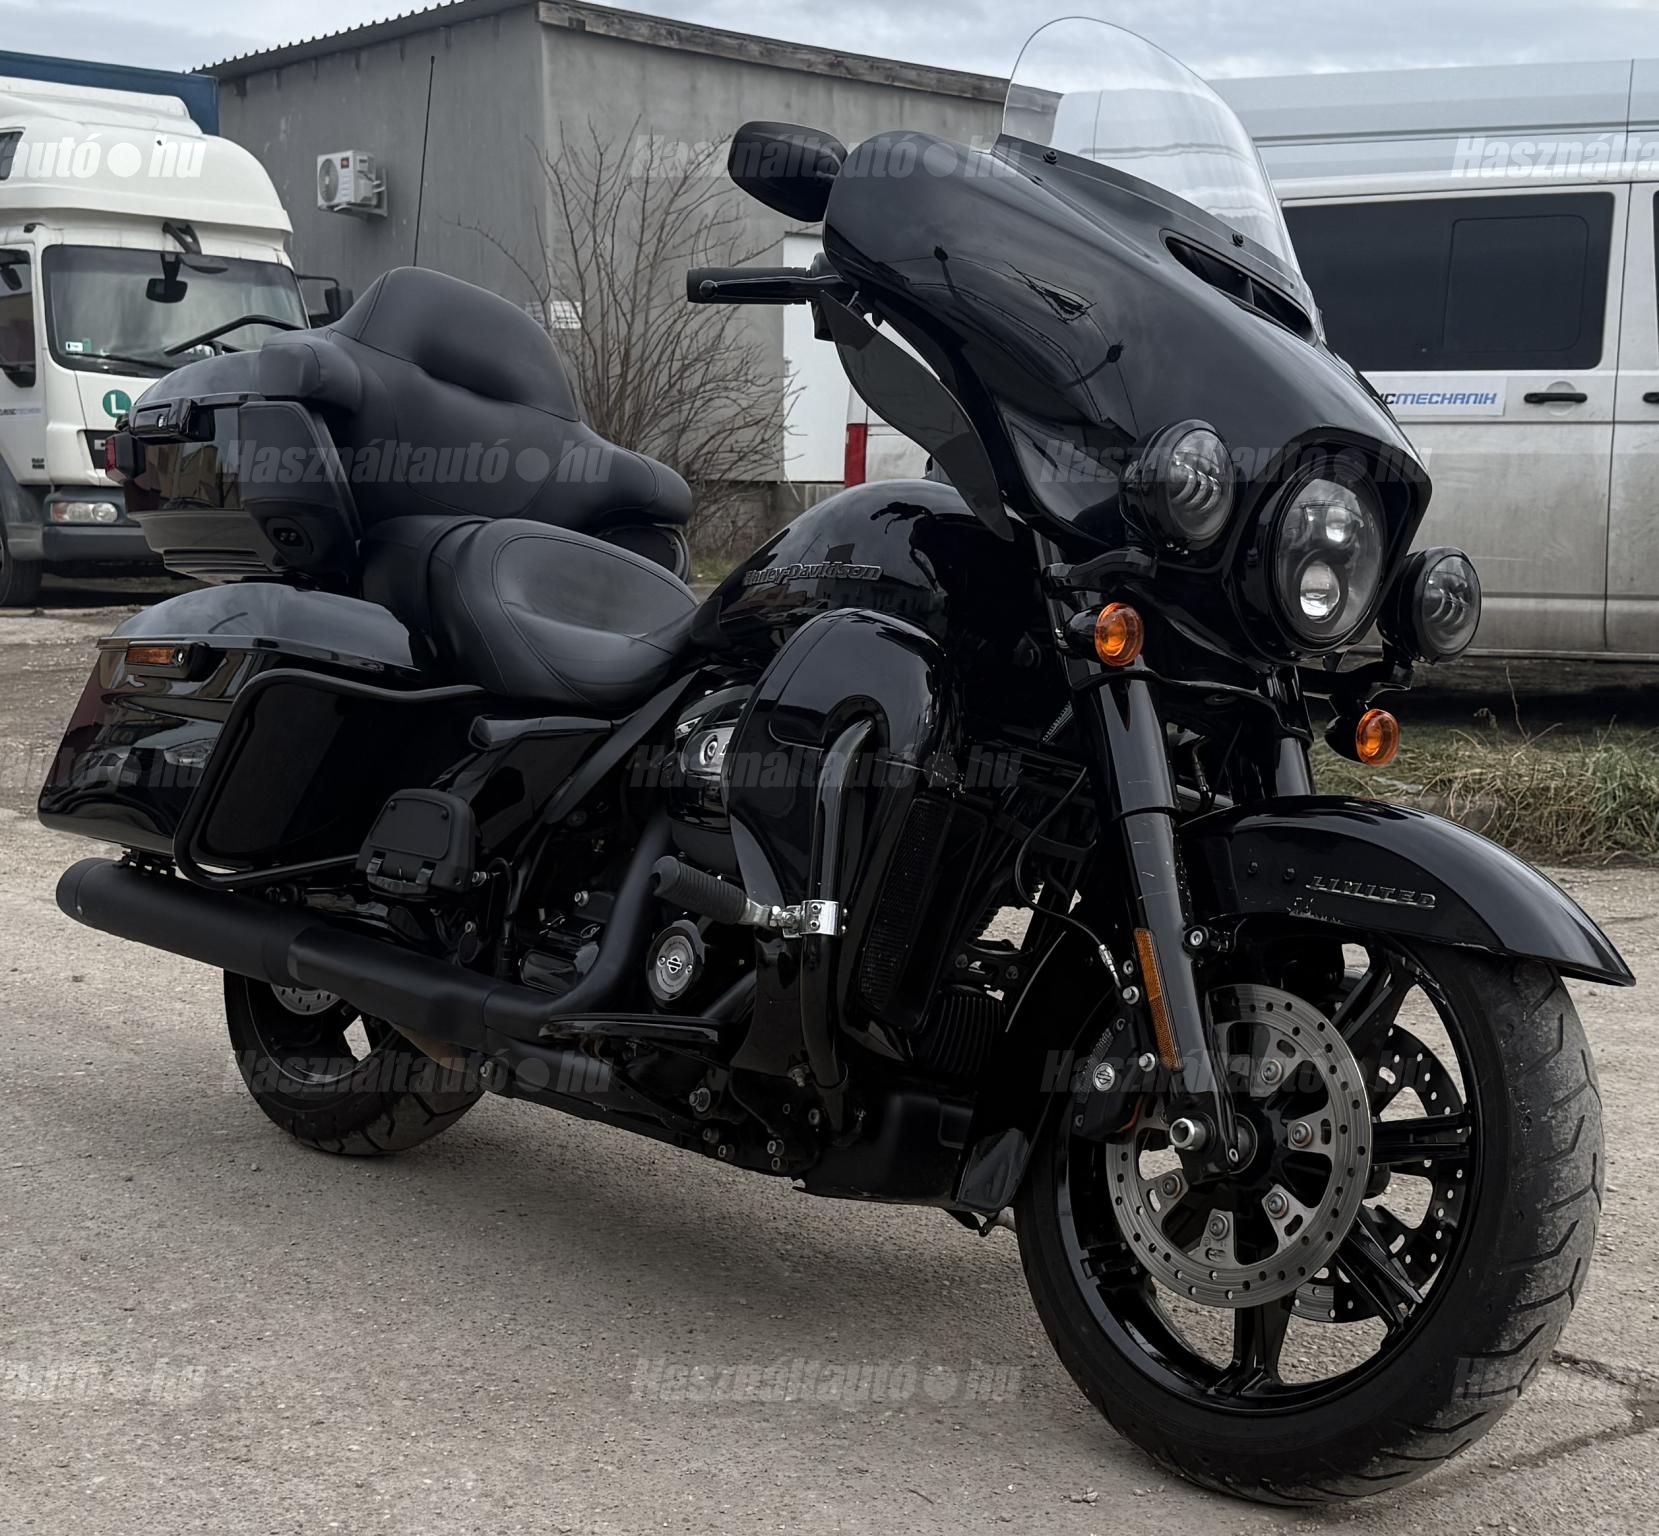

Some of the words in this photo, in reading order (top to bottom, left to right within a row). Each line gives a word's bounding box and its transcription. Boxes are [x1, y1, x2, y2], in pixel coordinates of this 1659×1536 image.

[111, 394, 126, 414] L
[744, 561, 882, 586] Harley-Davidson
[1308, 875, 1437, 908] LIMITED
